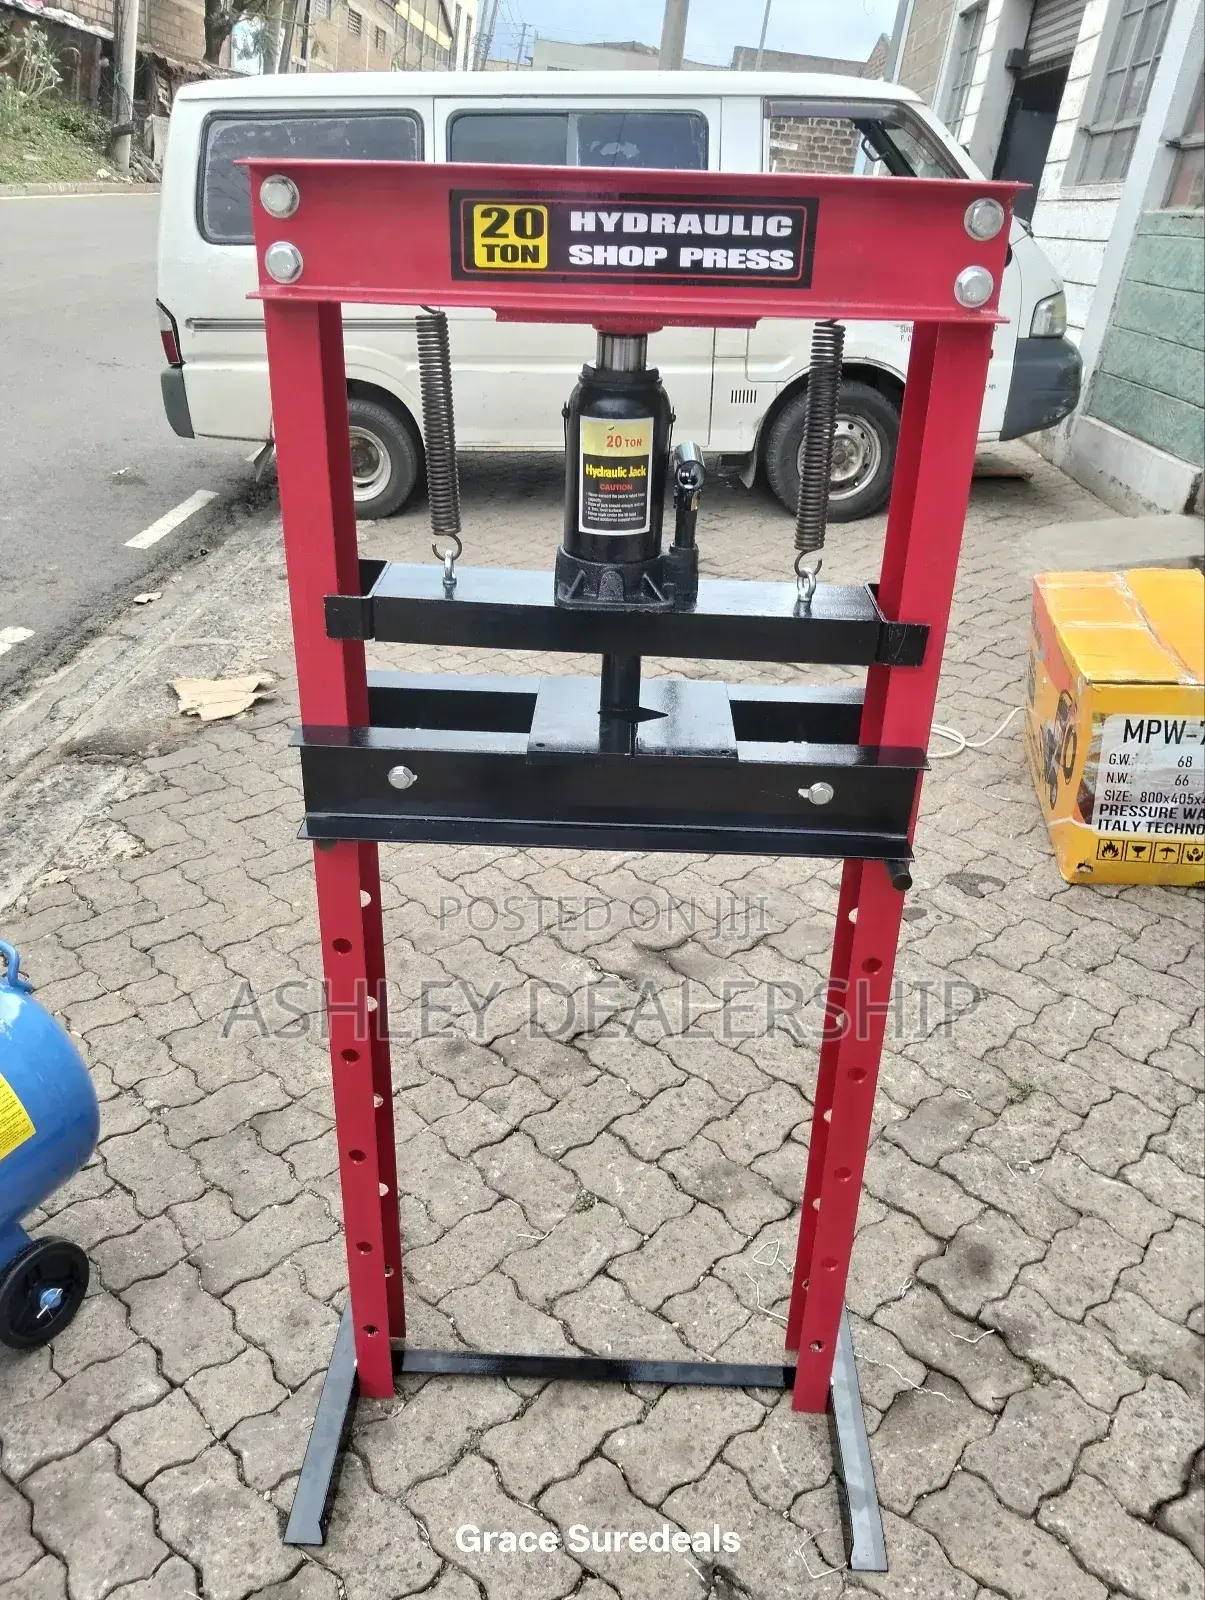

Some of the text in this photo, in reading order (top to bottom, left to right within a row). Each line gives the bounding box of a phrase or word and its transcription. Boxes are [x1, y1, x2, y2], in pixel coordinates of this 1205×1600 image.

[480, 206, 545, 239] 20
[570, 210, 793, 237] HYDRAULIC
[482, 243, 540, 264] TON
[568, 244, 794, 270] SHOP PRESS
[607, 435, 642, 448] 20 TON
[586, 464, 646, 478] Hydraulic Jack
[1109, 753, 1193, 768] G.W.: 68
[1106, 772, 1189, 786] N.W.: 66
[1104, 789, 1132, 802] SIZE:
[1099, 803, 1178, 819] PRESSURE
[1098, 819, 1205, 836] ITALY TECHNO
